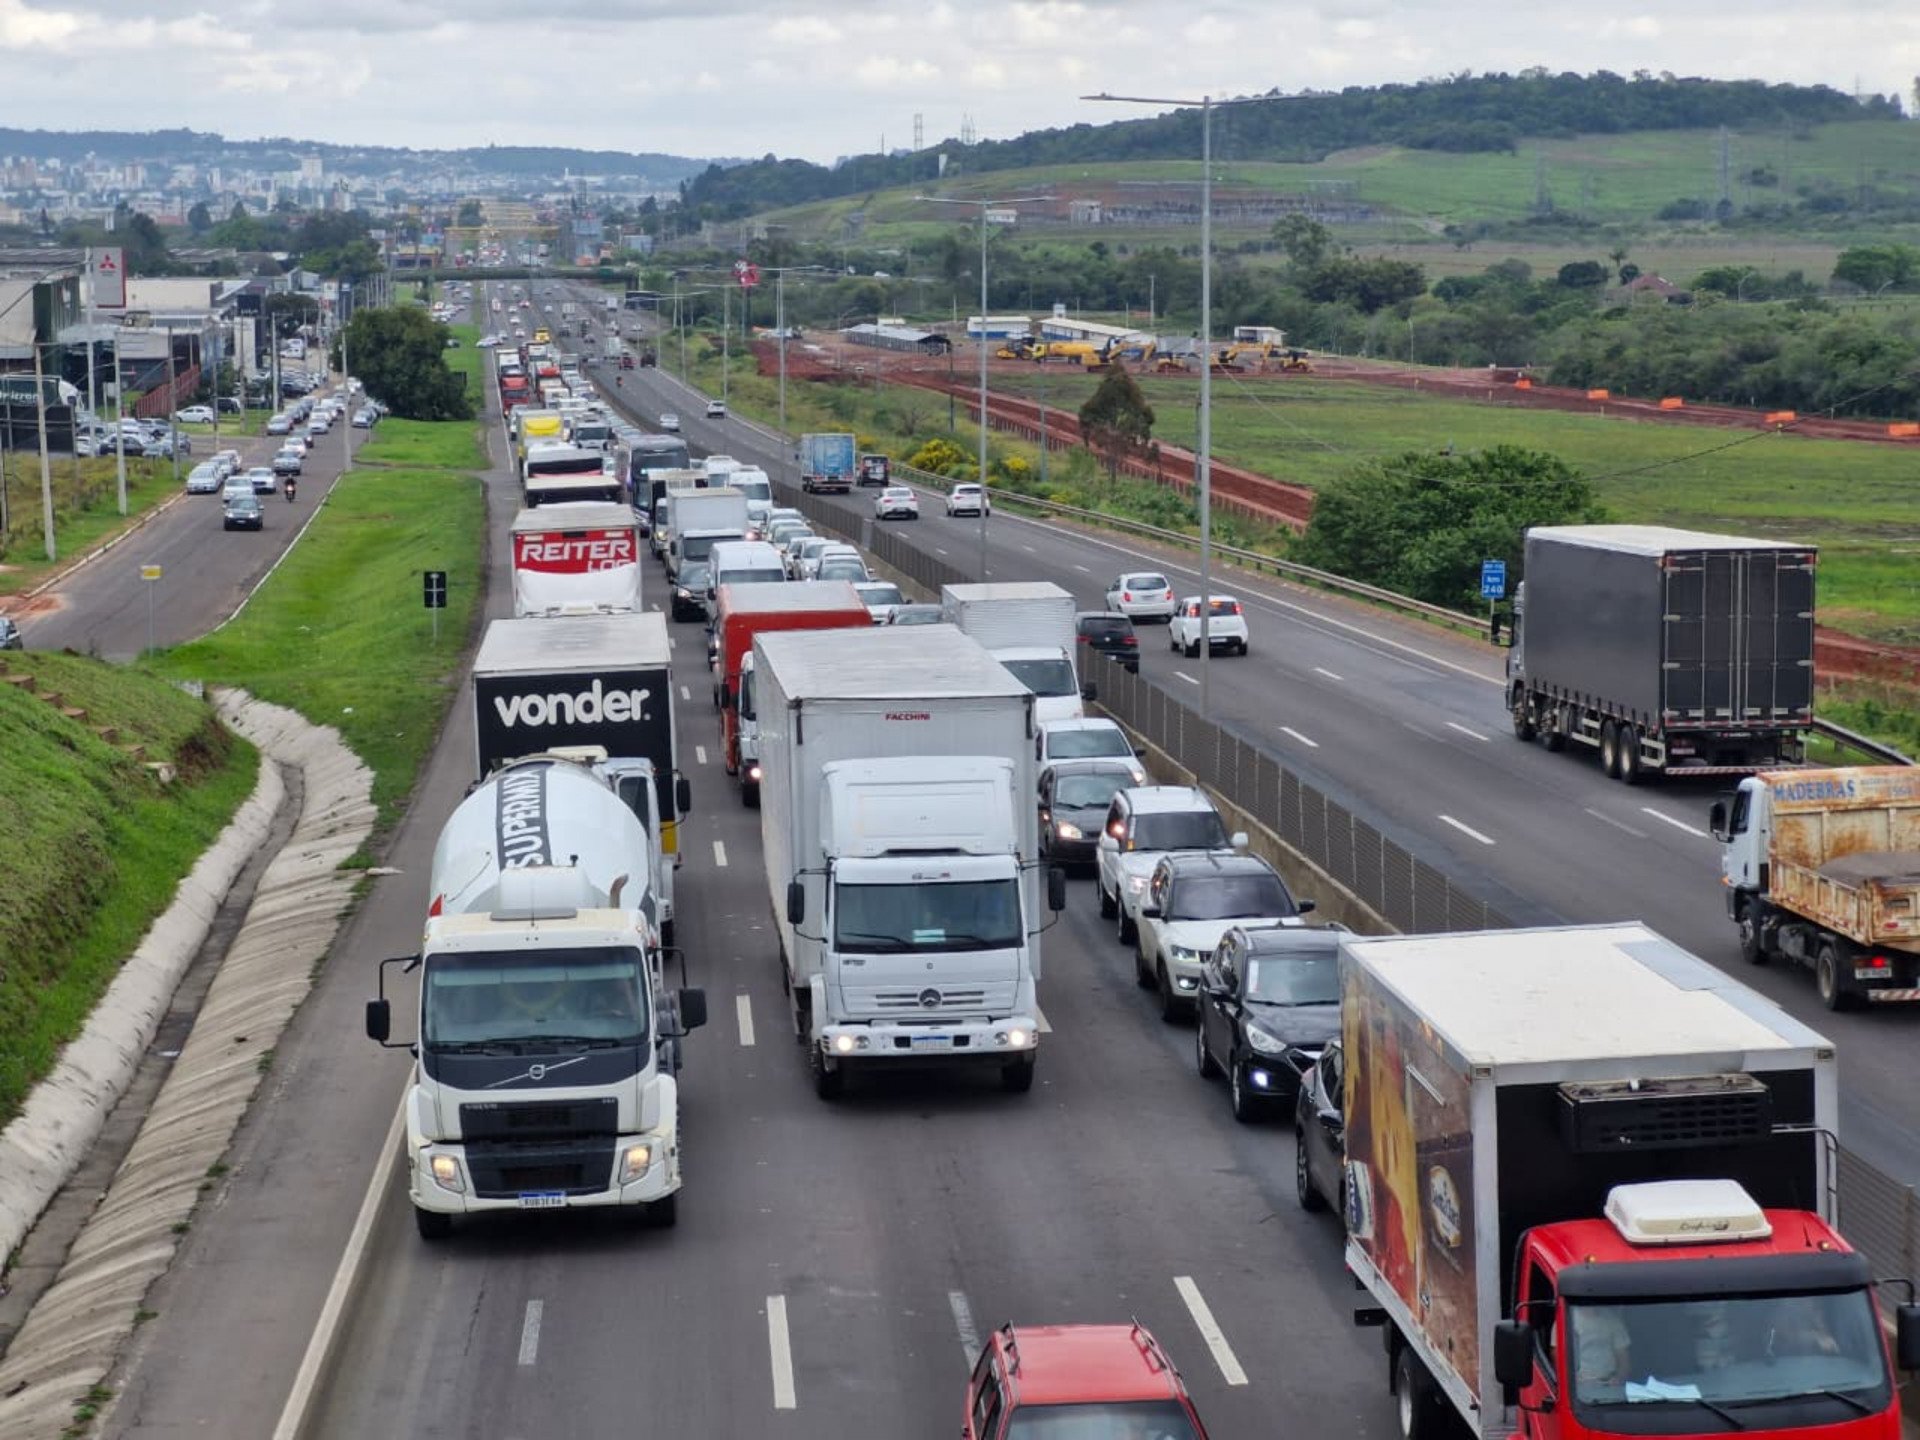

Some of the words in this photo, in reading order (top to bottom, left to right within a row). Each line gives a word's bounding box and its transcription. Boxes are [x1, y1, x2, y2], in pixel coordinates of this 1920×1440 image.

[521, 539, 631, 562] REITER
[885, 713, 931, 721] FACCHINI
[1774, 779, 1855, 800] MADEBRAS
[502, 768, 544, 868] SUPERMIX
